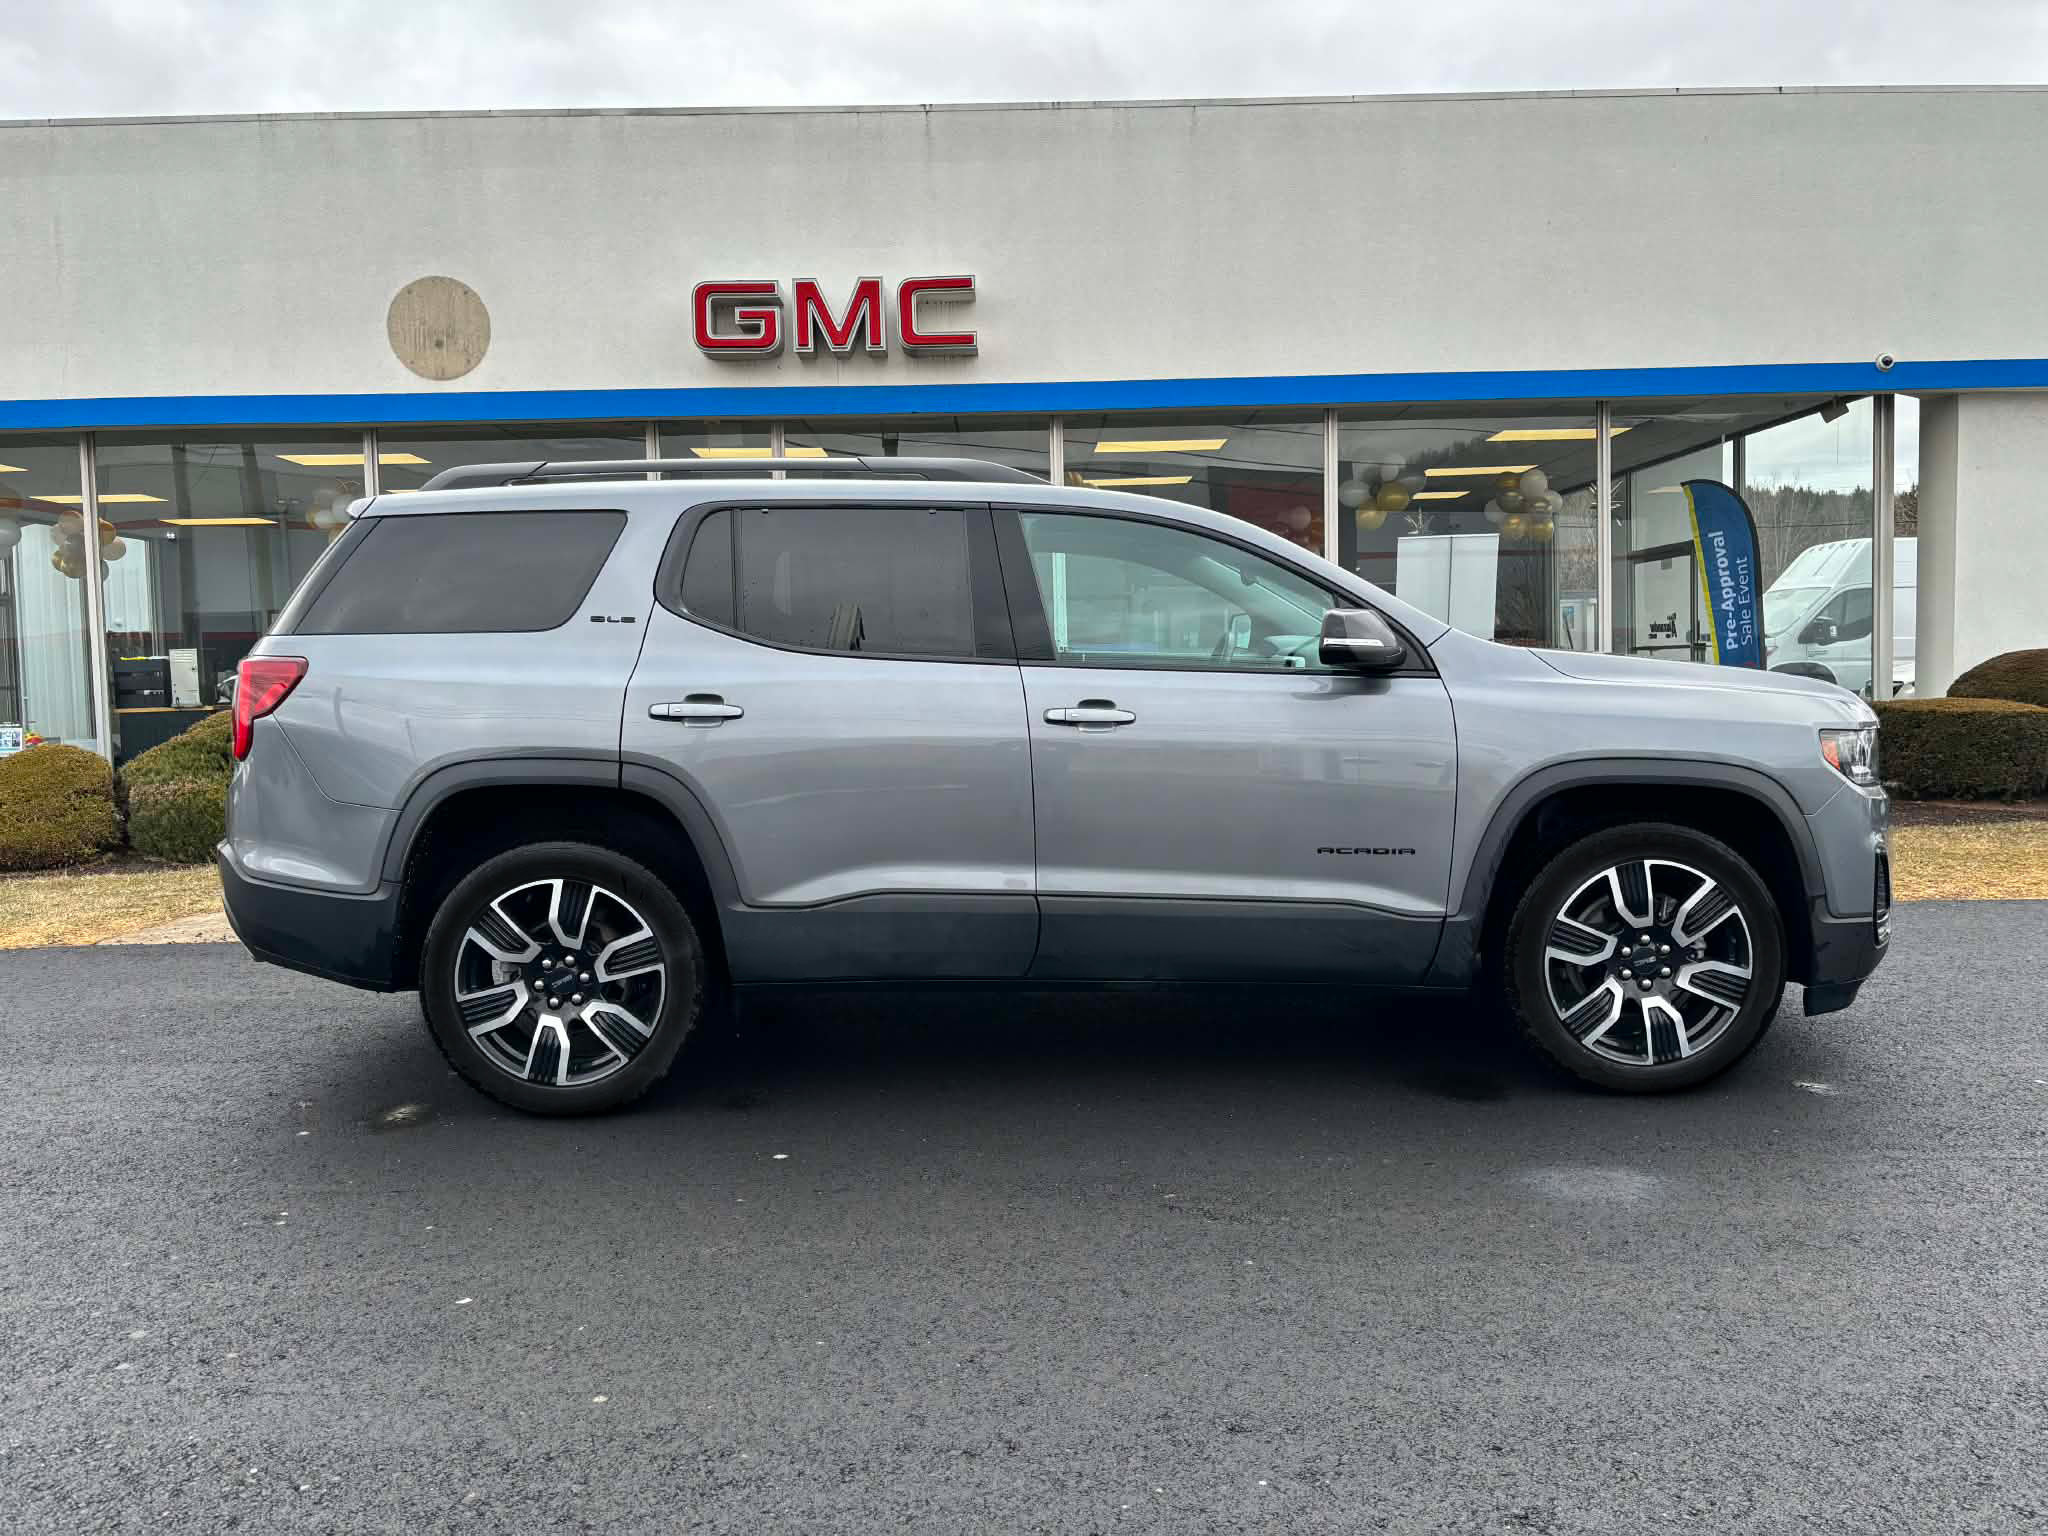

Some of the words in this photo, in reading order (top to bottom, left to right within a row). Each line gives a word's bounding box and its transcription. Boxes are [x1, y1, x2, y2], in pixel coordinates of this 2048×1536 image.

[691, 275, 978, 353] GMC
[1708, 530, 1738, 650] Pre-Approval
[1736, 556, 1751, 605] Event
[1740, 609, 1753, 646] Sale
[1317, 847, 1416, 855] ACADIA
